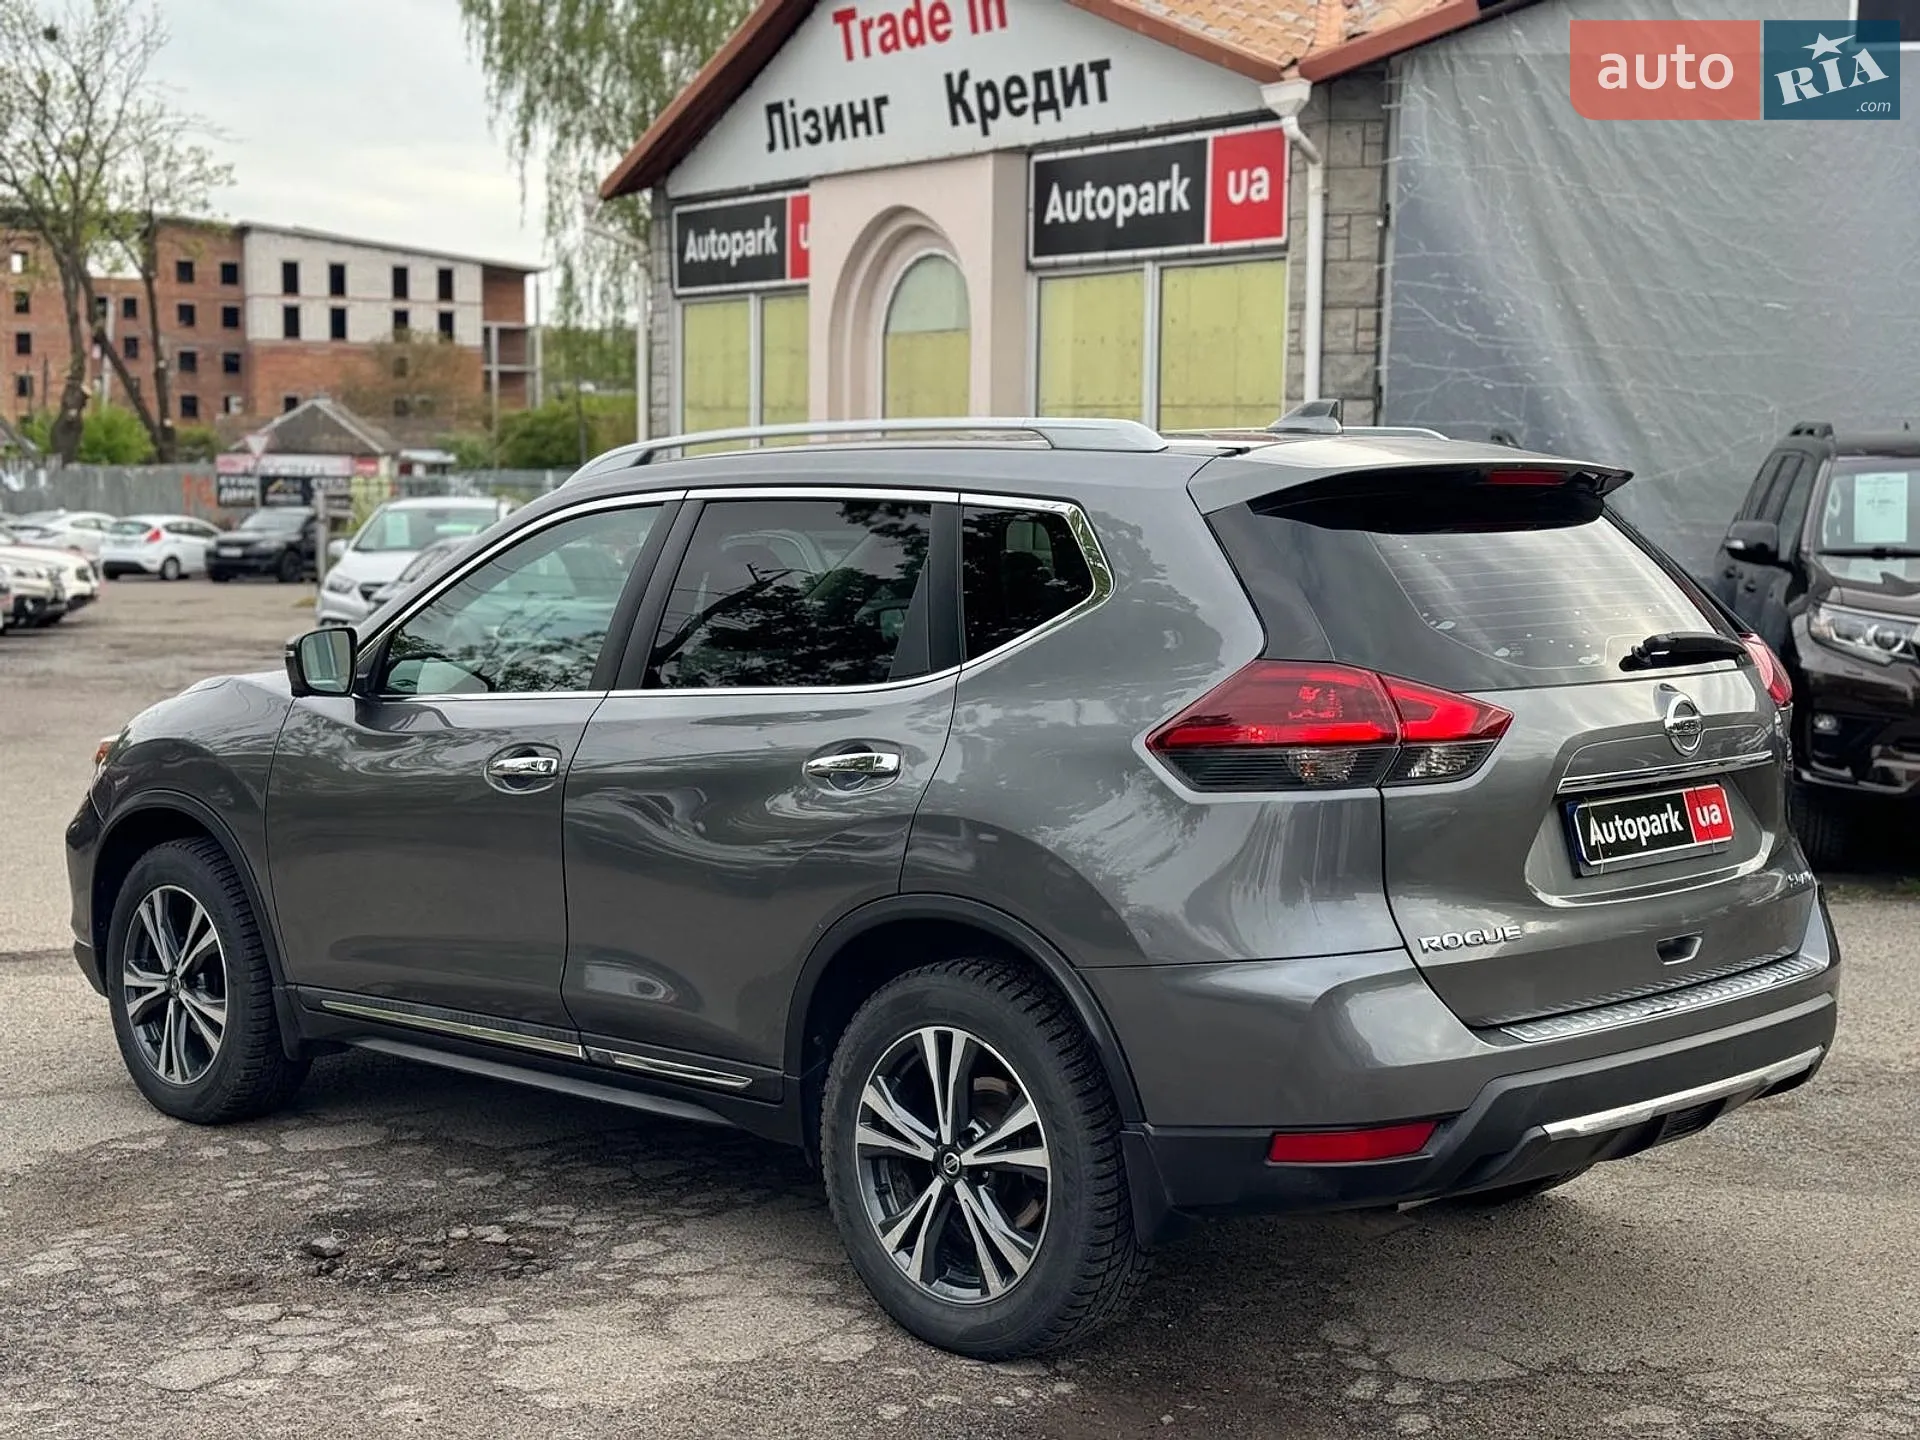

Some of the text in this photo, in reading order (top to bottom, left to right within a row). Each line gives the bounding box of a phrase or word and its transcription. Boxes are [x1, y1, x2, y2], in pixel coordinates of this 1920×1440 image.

[832, 0, 953, 62] Trade
[764, 58, 1112, 153] Лізинг Кредит
[1043, 163, 1270, 229] Autopark ua
[684, 214, 778, 268] Autopark
[1590, 803, 1723, 847] Autopark ua
[1418, 925, 1522, 954] ROGUE
